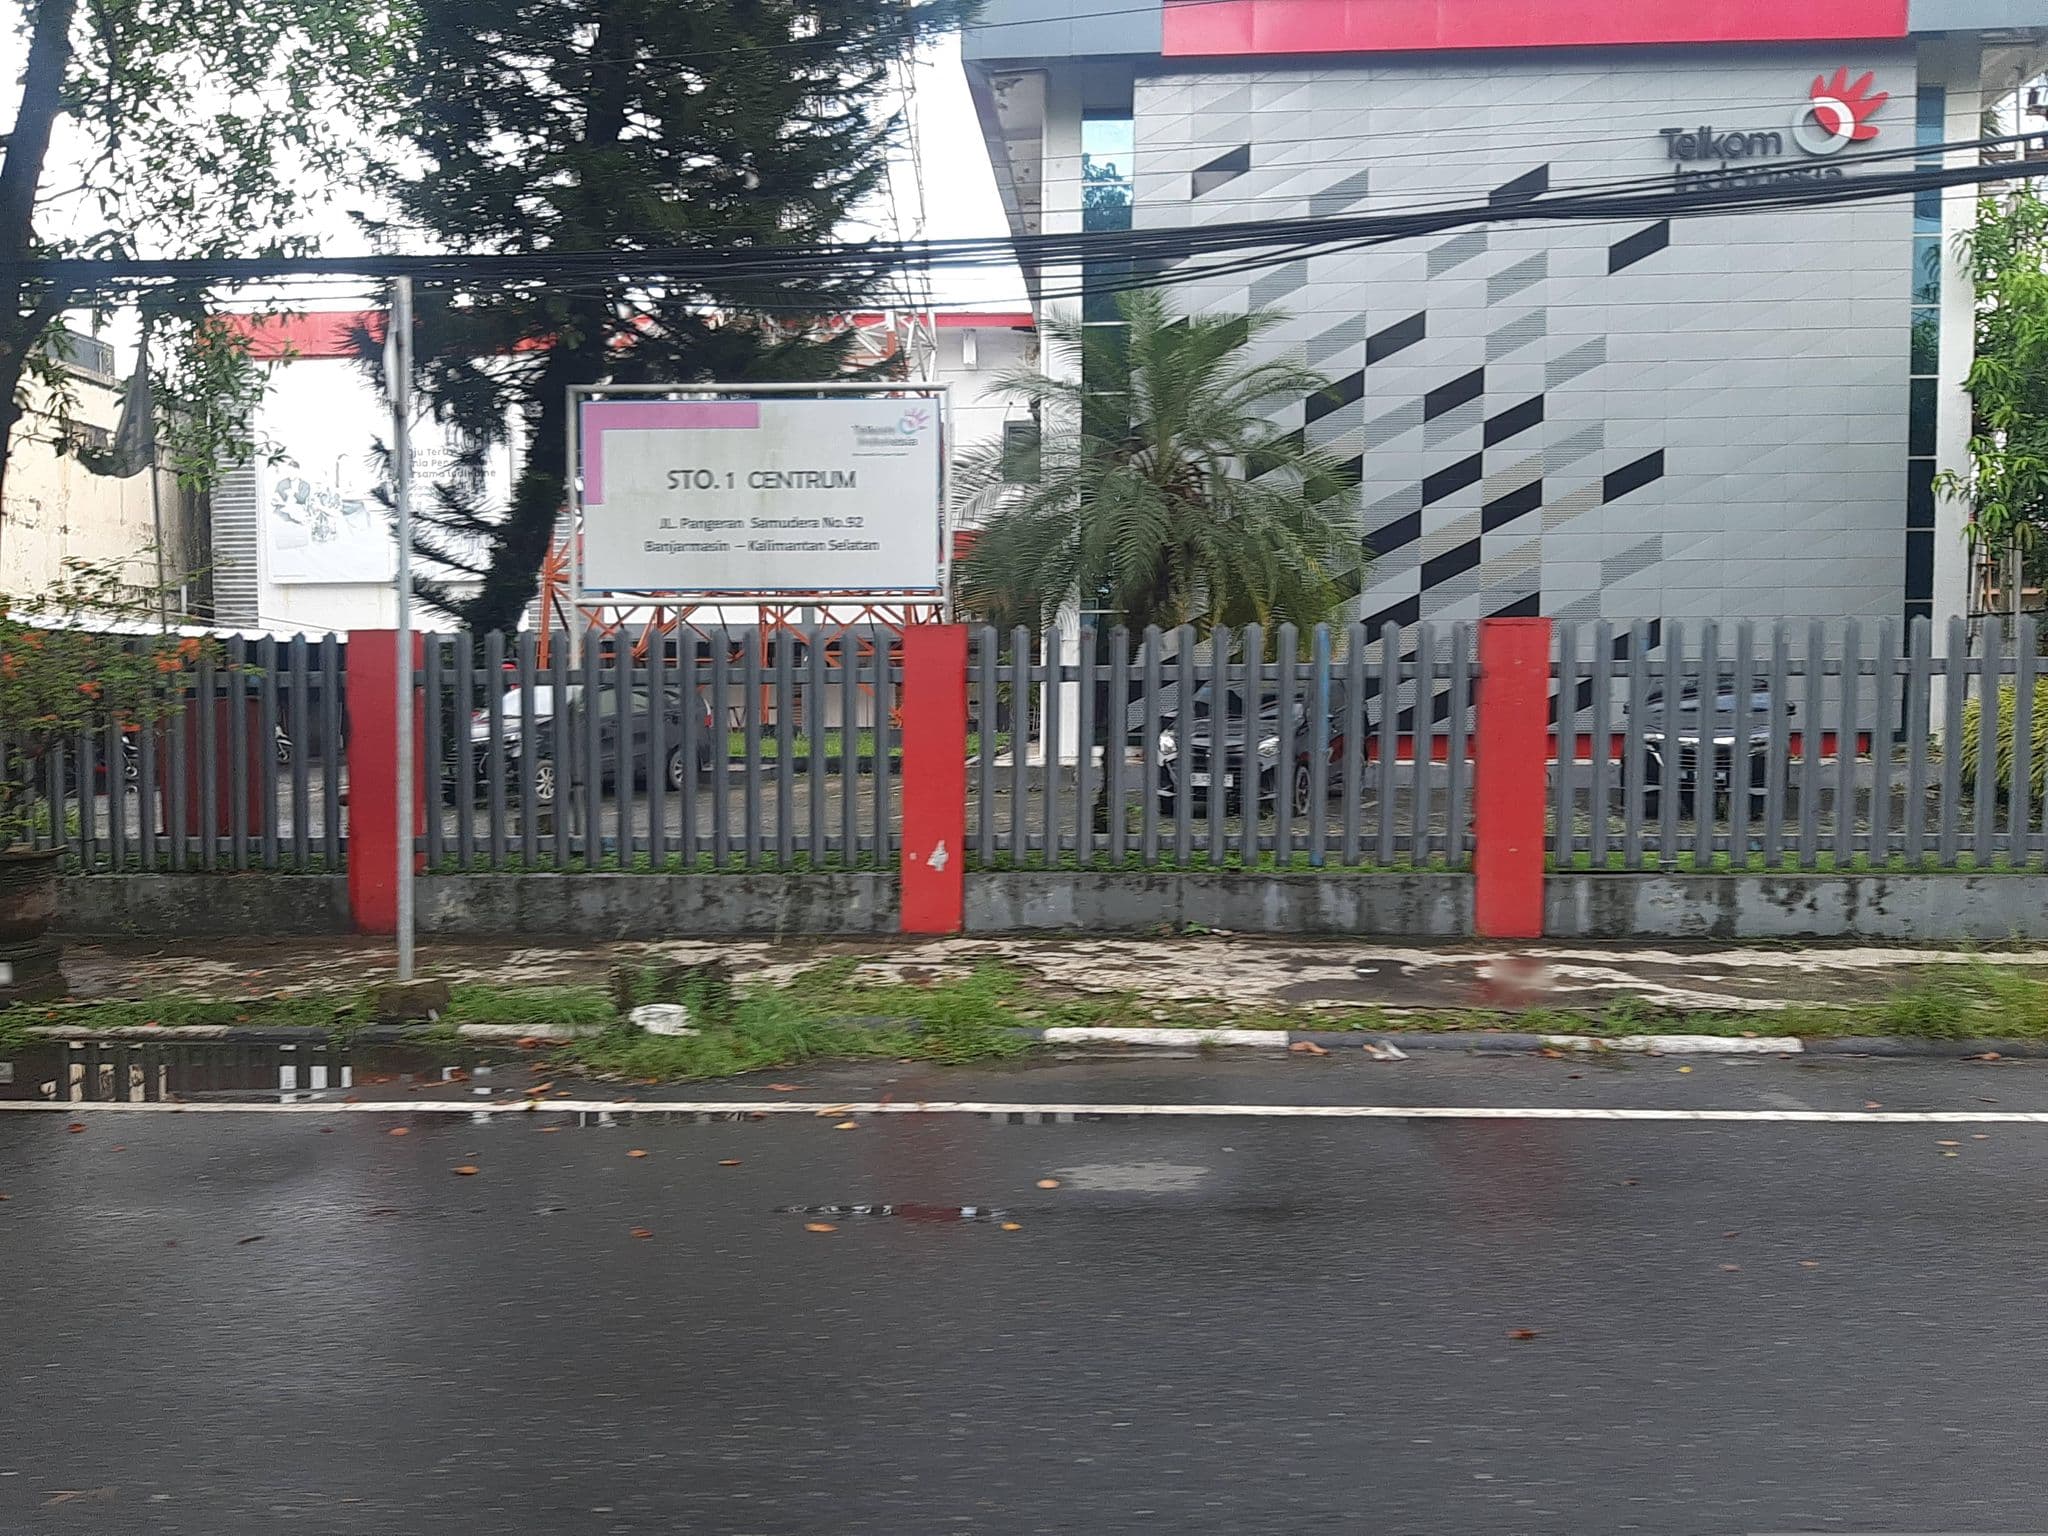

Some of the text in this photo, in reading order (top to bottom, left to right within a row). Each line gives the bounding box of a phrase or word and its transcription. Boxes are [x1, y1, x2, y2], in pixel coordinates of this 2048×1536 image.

[1660, 126, 1783, 159] Telkom
[748, 470, 856, 489] CENTRUM
[680, 517, 744, 531] Pangeran
[750, 516, 820, 528] Samudera
[645, 540, 730, 554] Banjarmasin
[747, 540, 827, 551] Kalimantan
[828, 539, 880, 551] Selatan
